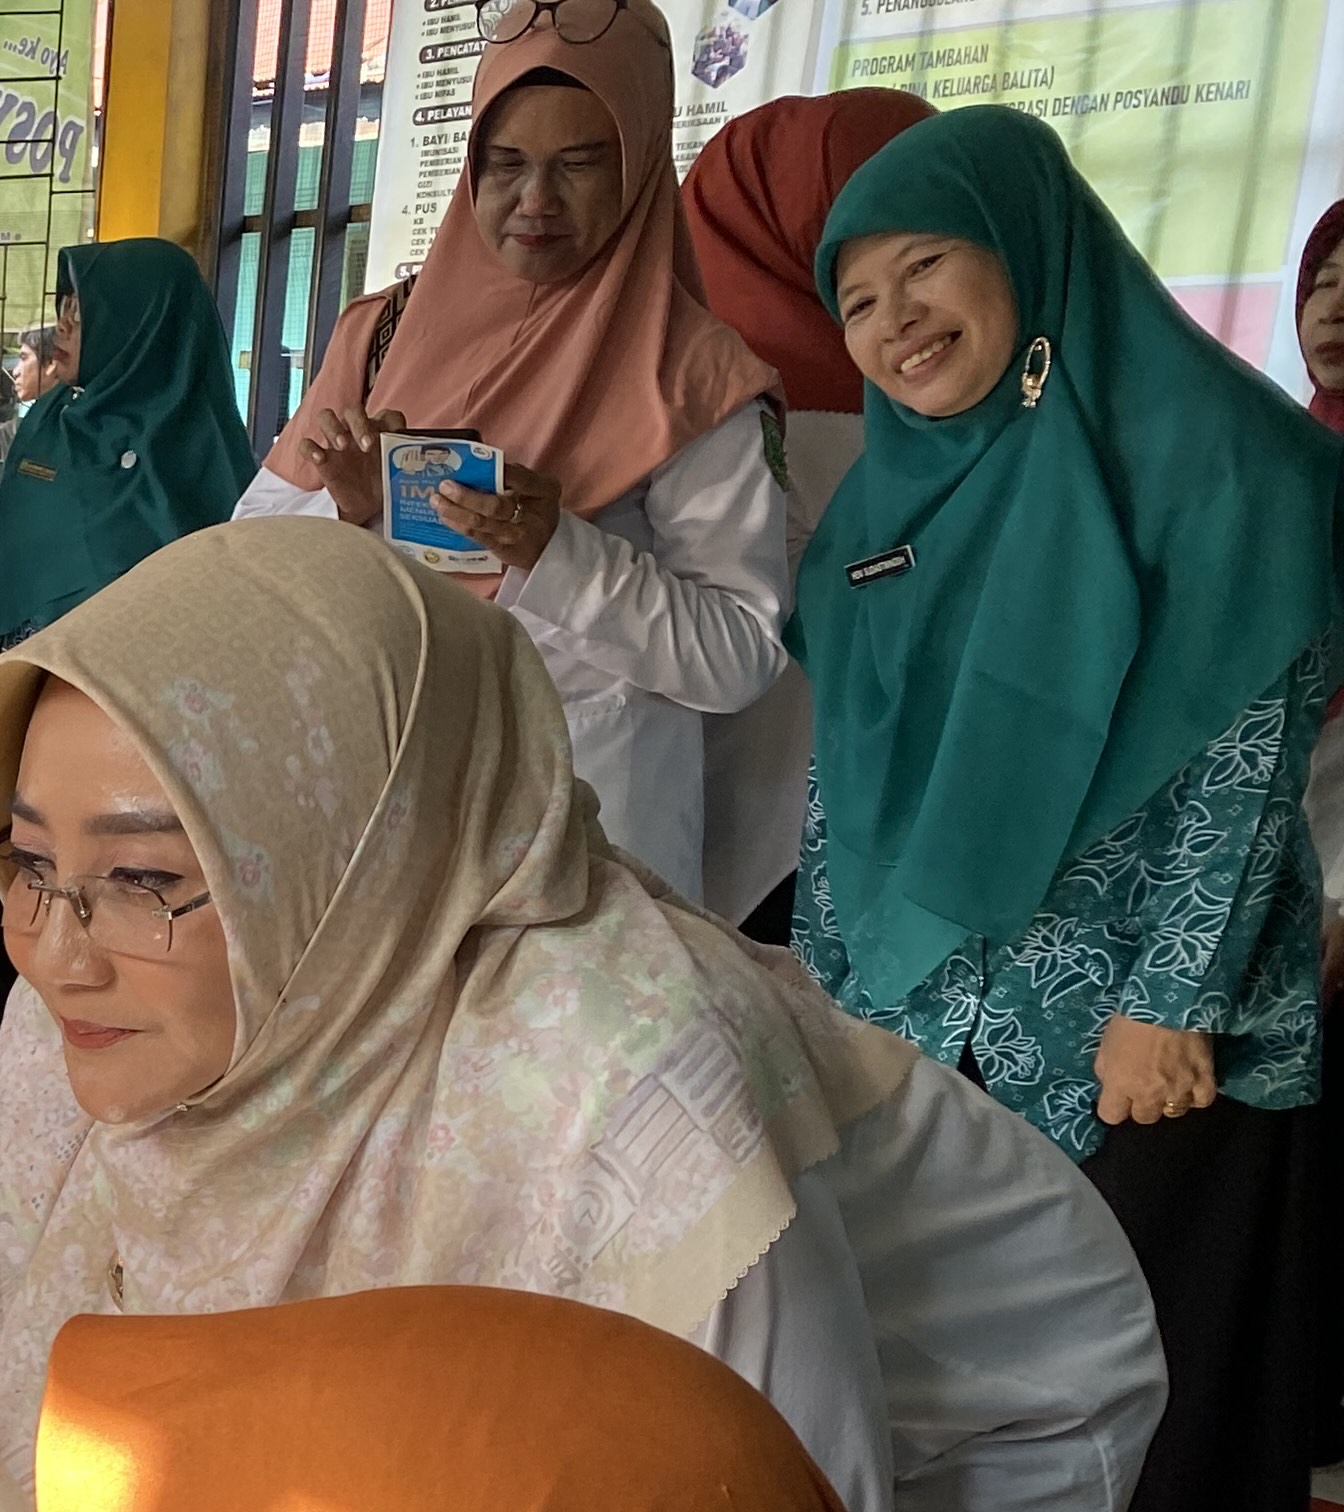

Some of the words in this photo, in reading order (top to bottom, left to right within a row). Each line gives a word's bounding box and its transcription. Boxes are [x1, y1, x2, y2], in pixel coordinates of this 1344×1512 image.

[437, 41, 488, 58] PENCATAT
[852, 53, 914, 77] PROGRAM
[919, 44, 989, 69] TAMBAHAN
[933, 74, 997, 99] KELUARGA
[1002, 65, 1055, 91] BALITA)
[1052, 92, 1111, 117] DENGAN
[1113, 85, 1191, 111] POSYANDU
[1195, 80, 1251, 104] KENARI
[415, 111, 424, 122] 4.
[427, 105, 472, 121] PELAYAN
[686, 101, 728, 117] HAMIL
[673, 116, 721, 129] ERIKSAAN
[415, 202, 437, 214] PUS
